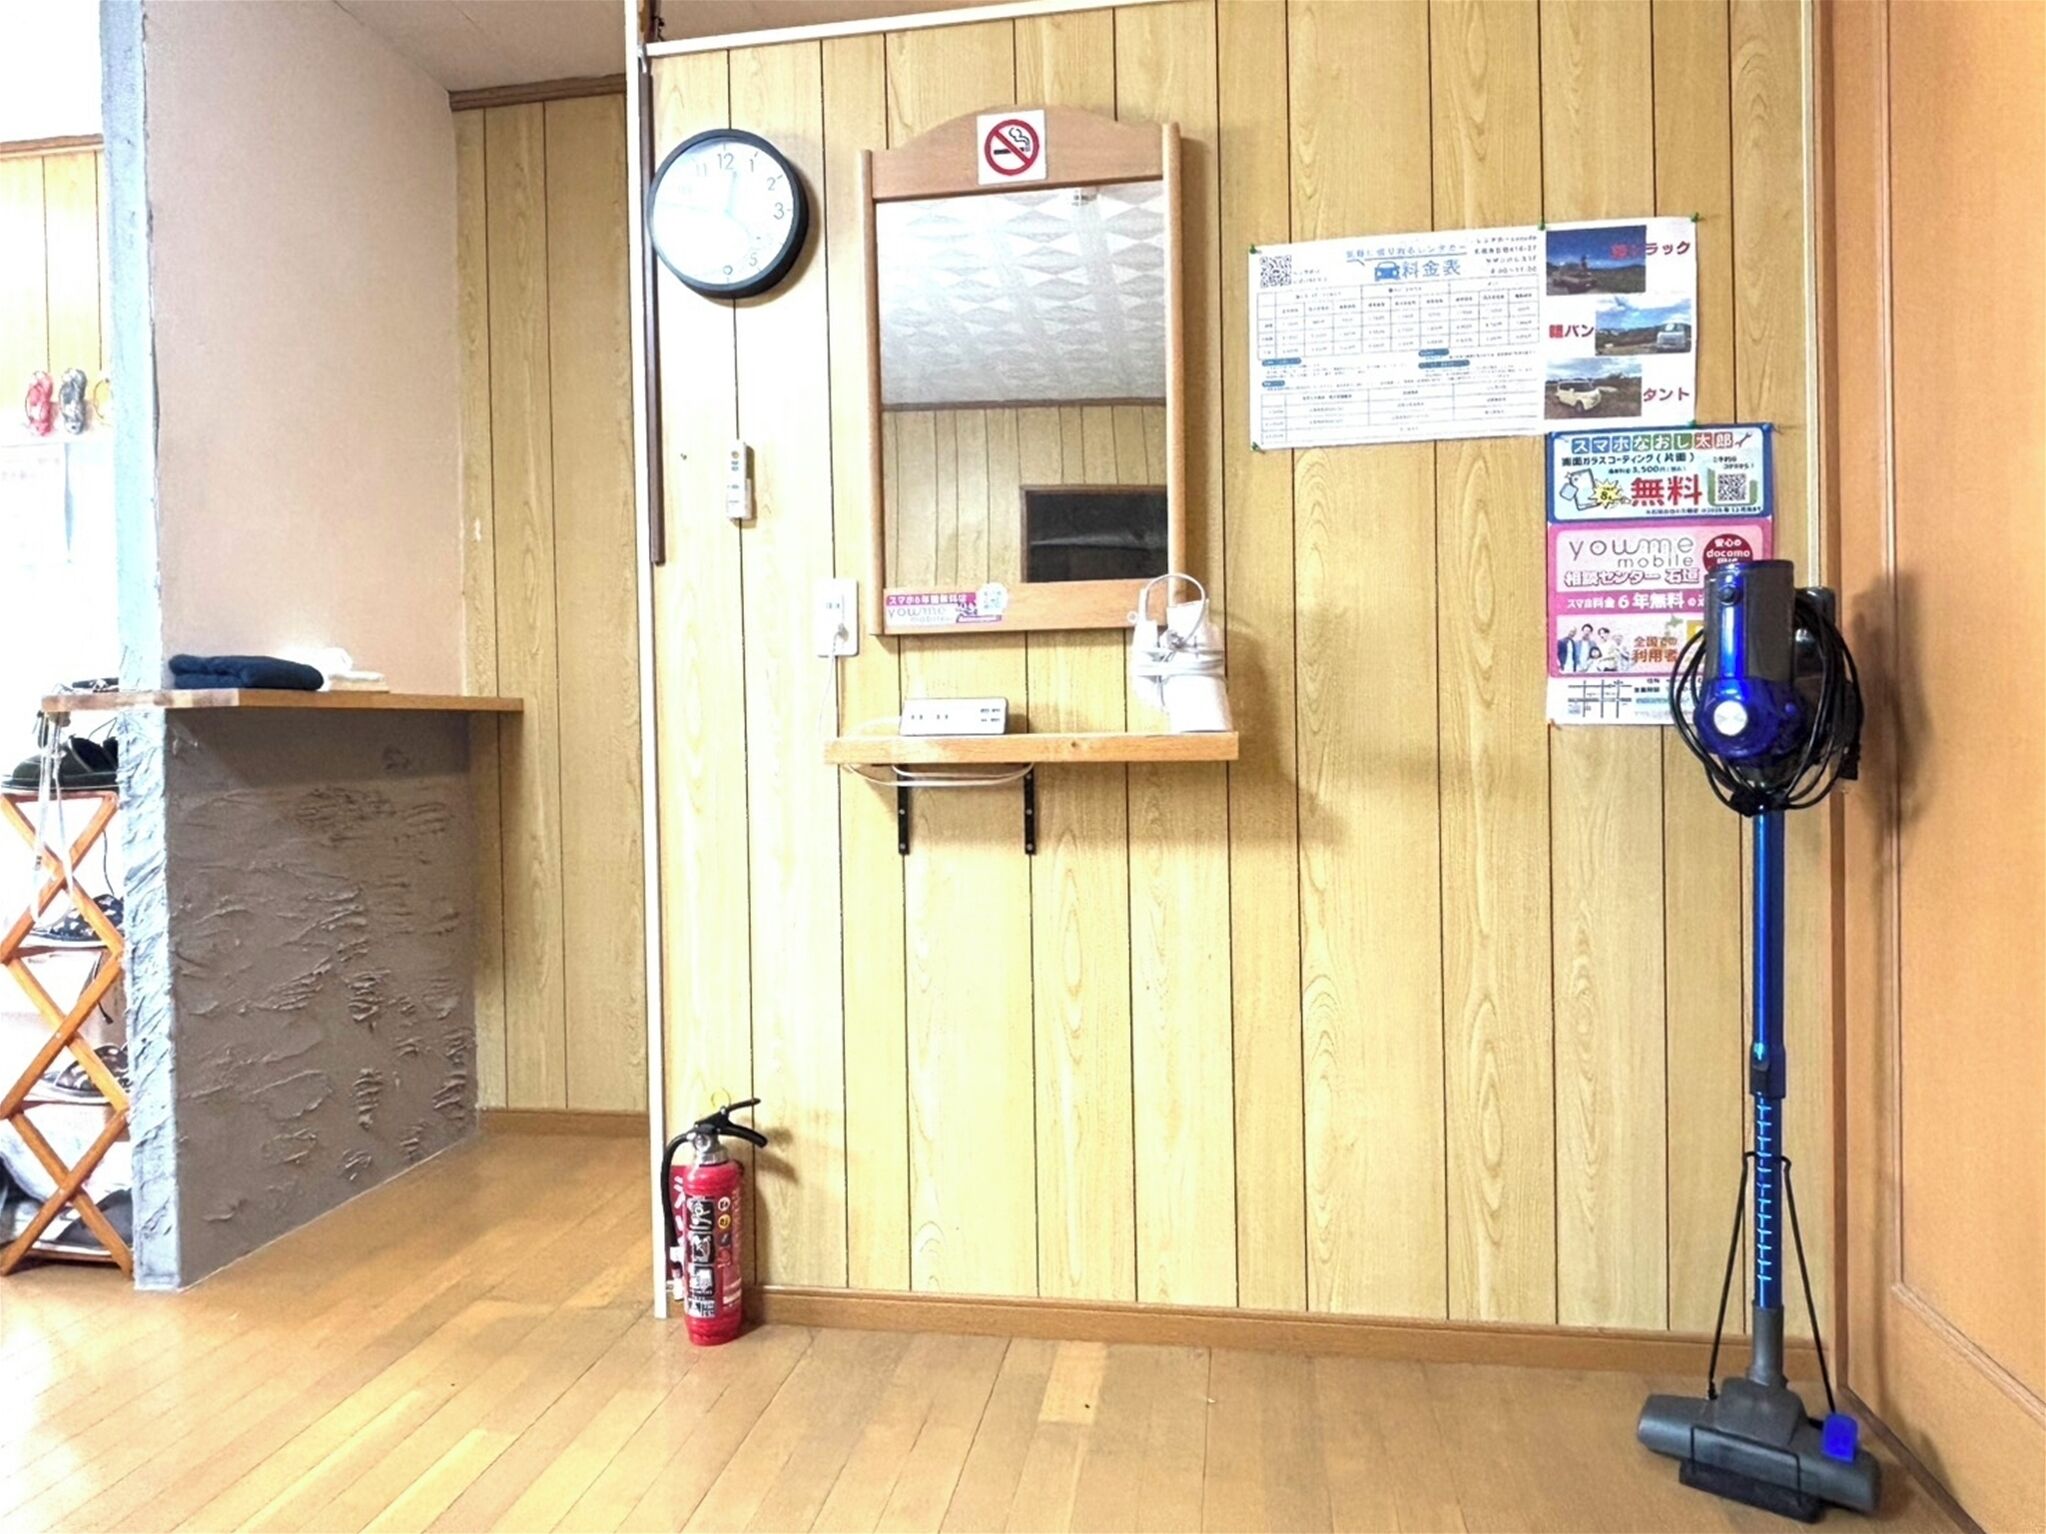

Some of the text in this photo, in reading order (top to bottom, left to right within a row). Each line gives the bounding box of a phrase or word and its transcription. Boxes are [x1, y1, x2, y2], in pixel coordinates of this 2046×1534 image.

[717, 153, 734, 170] 12
[750, 159, 755, 172] 1
[766, 177, 776, 191] 2
[773, 202, 785, 220] 3
[750, 253, 759, 267] 5
[1402, 259, 1462, 279] 料金表
[1643, 387, 1690, 402] タント
[1572, 432, 1733, 454] スマホなおし太郎
[1630, 474, 1702, 507] 無料
[1617, 554, 1694, 568] mobile
[1706, 549, 1750, 558] docomo
[1564, 570, 1661, 587] 相談センター
